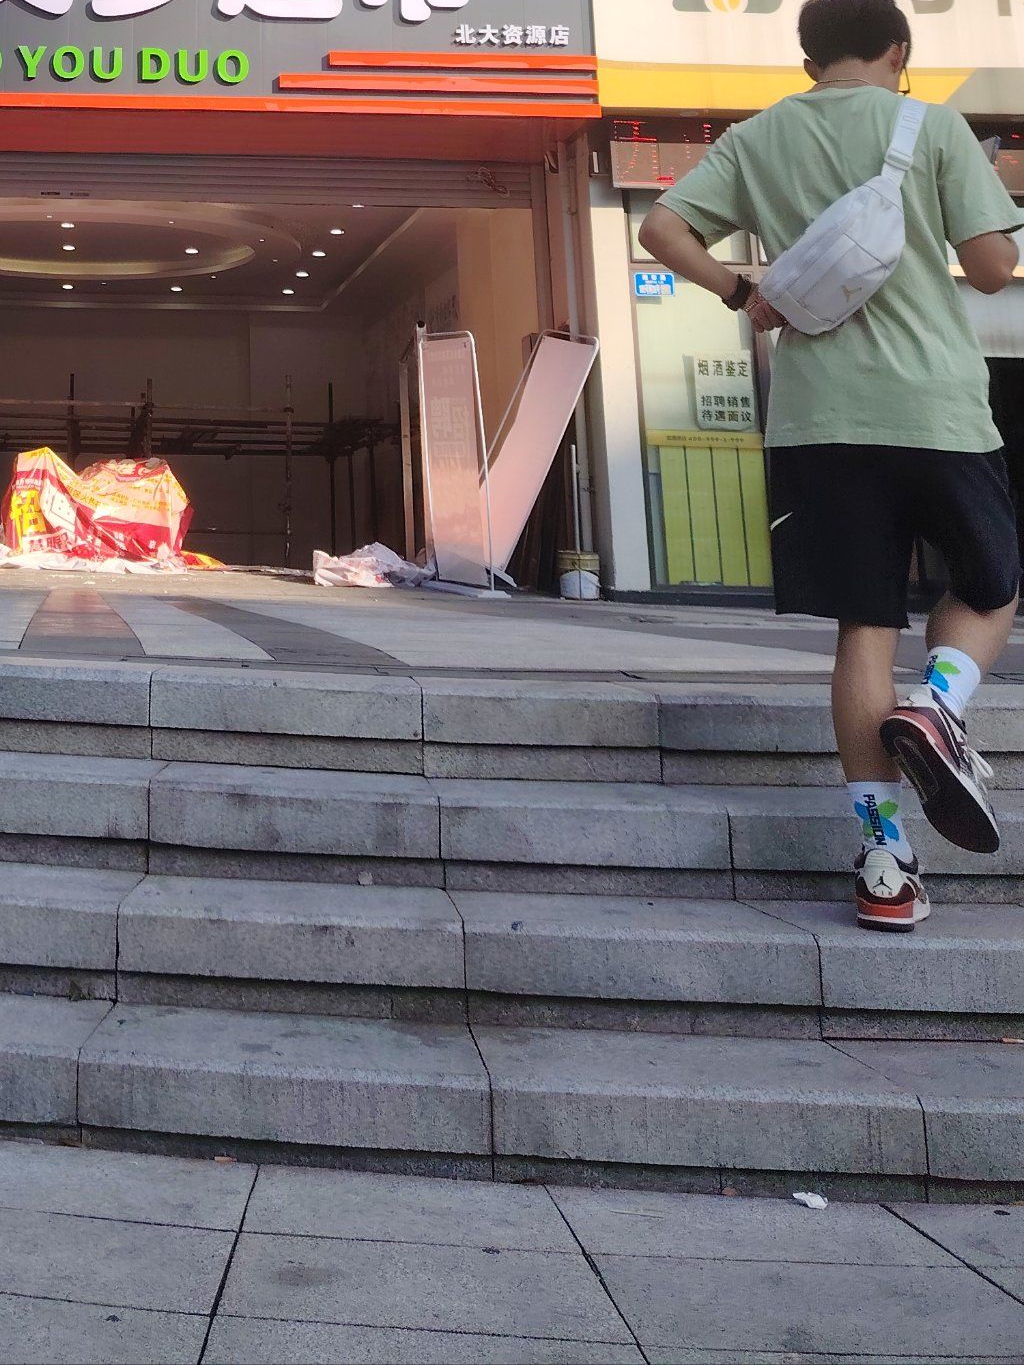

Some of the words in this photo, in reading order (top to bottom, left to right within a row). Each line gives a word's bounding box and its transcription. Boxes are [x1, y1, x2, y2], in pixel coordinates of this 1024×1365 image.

[455, 23, 571, 47] 北大资源店
[16, 44, 123, 81] YOU
[141, 47, 250, 85] DUO
[697, 359, 749, 379] 烟酒鉴定
[700, 395, 751, 409] 招聘销售
[701, 409, 752, 423] 待遇面议
[863, 794, 887, 846] PASSION
